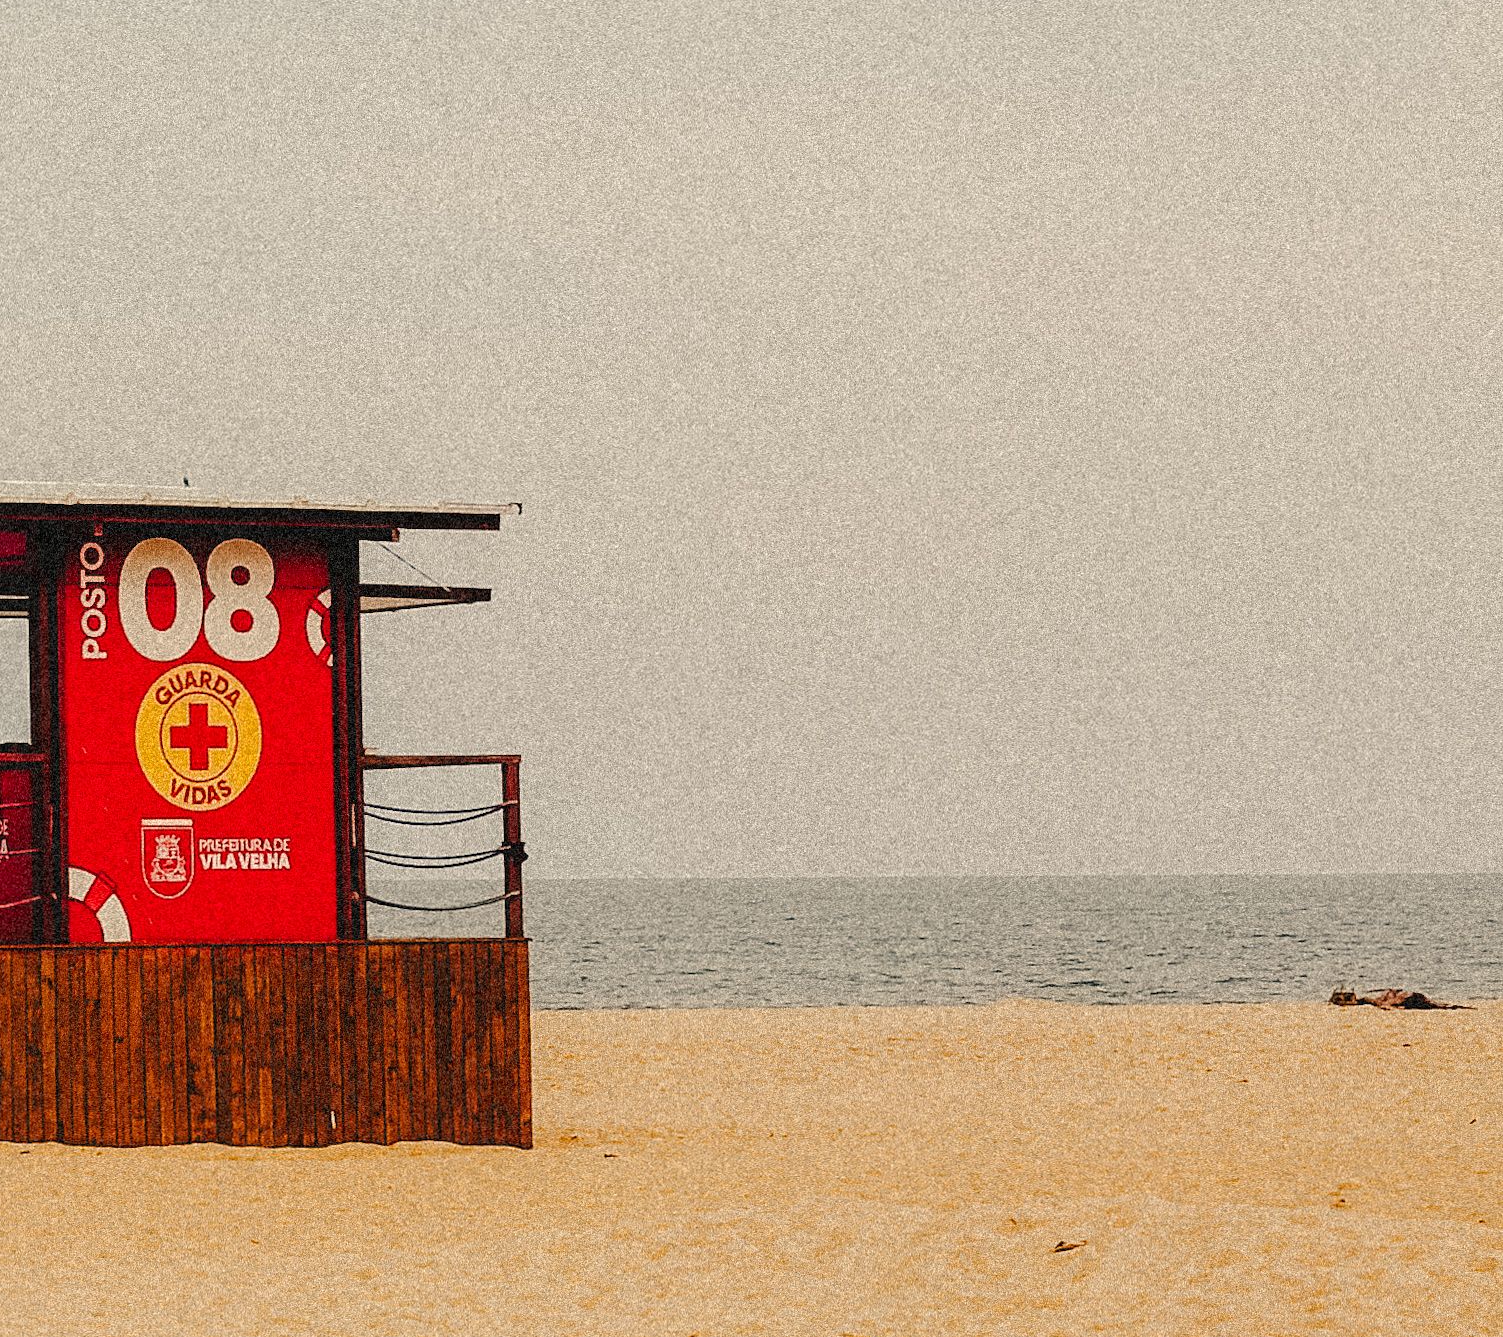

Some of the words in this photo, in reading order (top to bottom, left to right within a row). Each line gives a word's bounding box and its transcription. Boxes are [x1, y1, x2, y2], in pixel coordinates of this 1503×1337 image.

[79, 541, 108, 660] POSTO
[118, 537, 280, 662] 08
[154, 670, 242, 708] GUARDA
[169, 778, 232, 805] VIDAS
[198, 837, 272, 852] PREFEITURA
[273, 837, 291, 852] DE
[199, 852, 238, 871] VILA
[238, 851, 291, 871] VELHA
